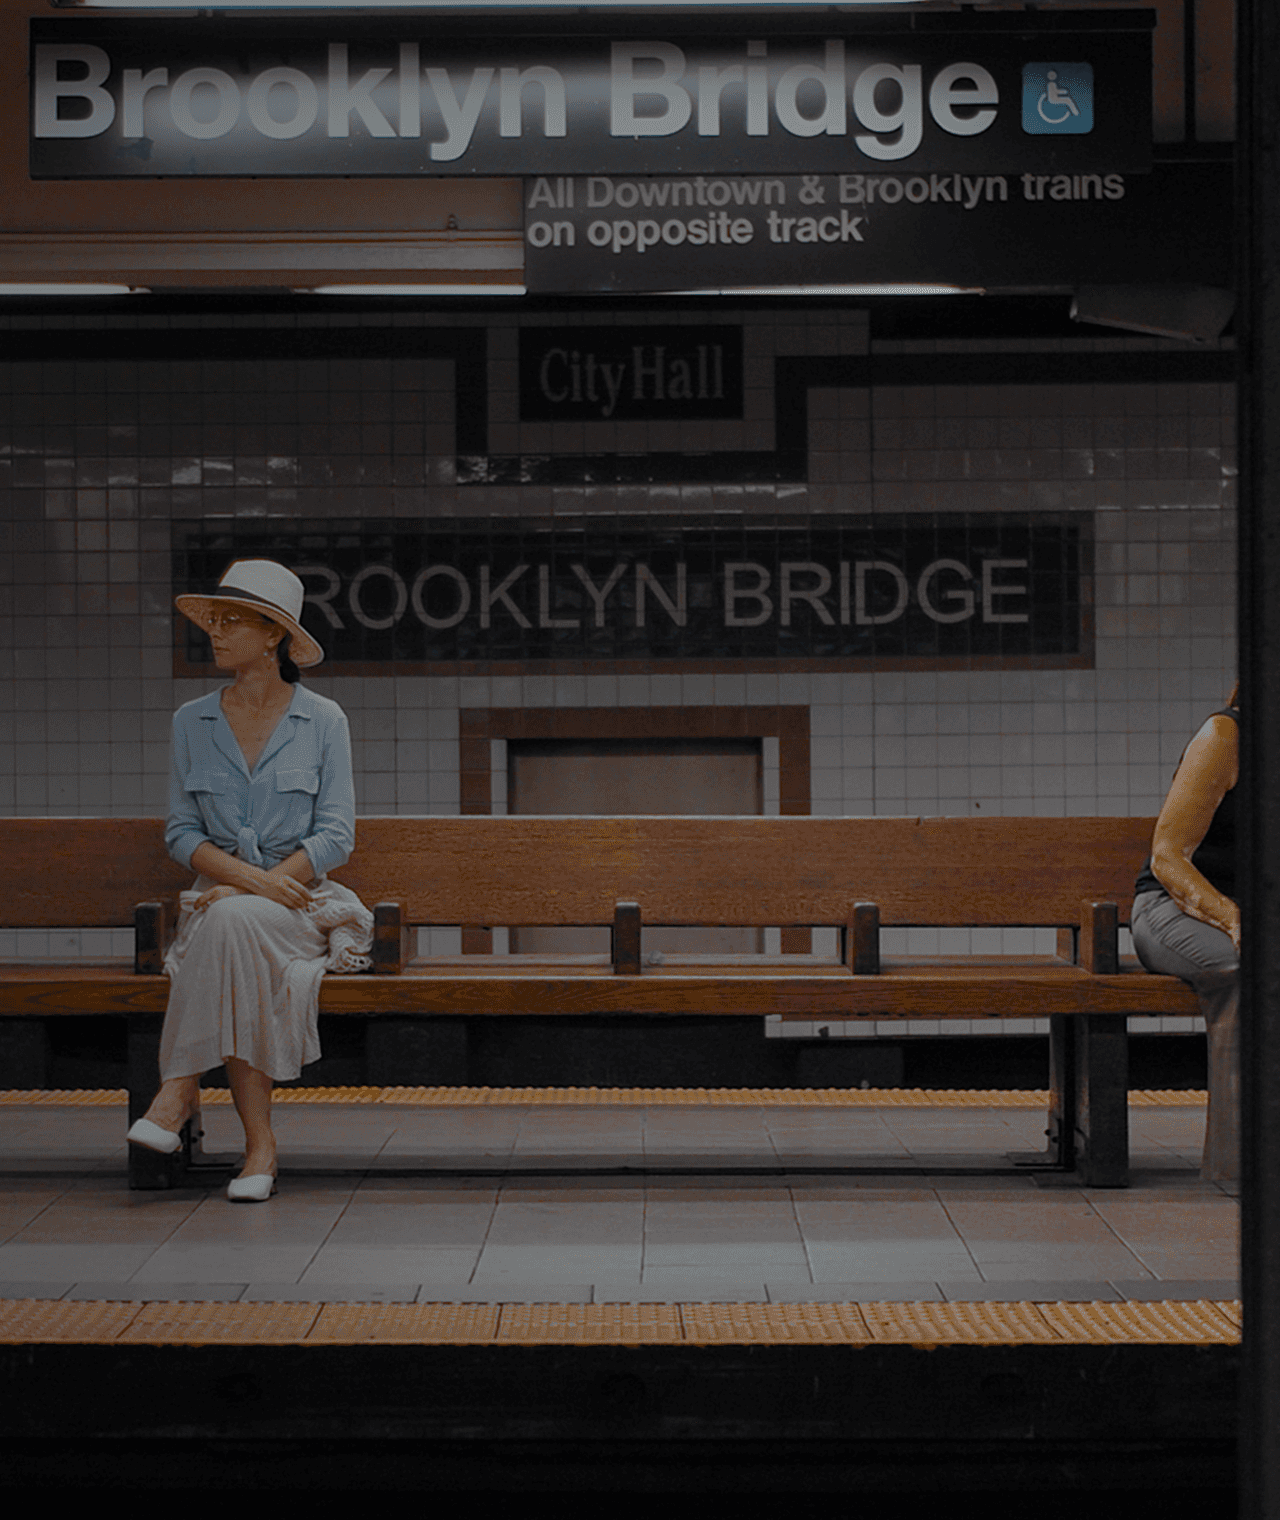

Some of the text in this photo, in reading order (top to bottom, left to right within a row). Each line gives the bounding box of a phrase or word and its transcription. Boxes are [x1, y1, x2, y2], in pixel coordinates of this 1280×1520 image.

[33, 38, 999, 162] Brooklyn Bridge
[528, 172, 1125, 210] All Downtown & Brooklyn trains
[527, 208, 865, 254] on opposite track
[539, 344, 724, 417] City Hall
[293, 559, 1030, 630] ROOKLYN BRIDGE
